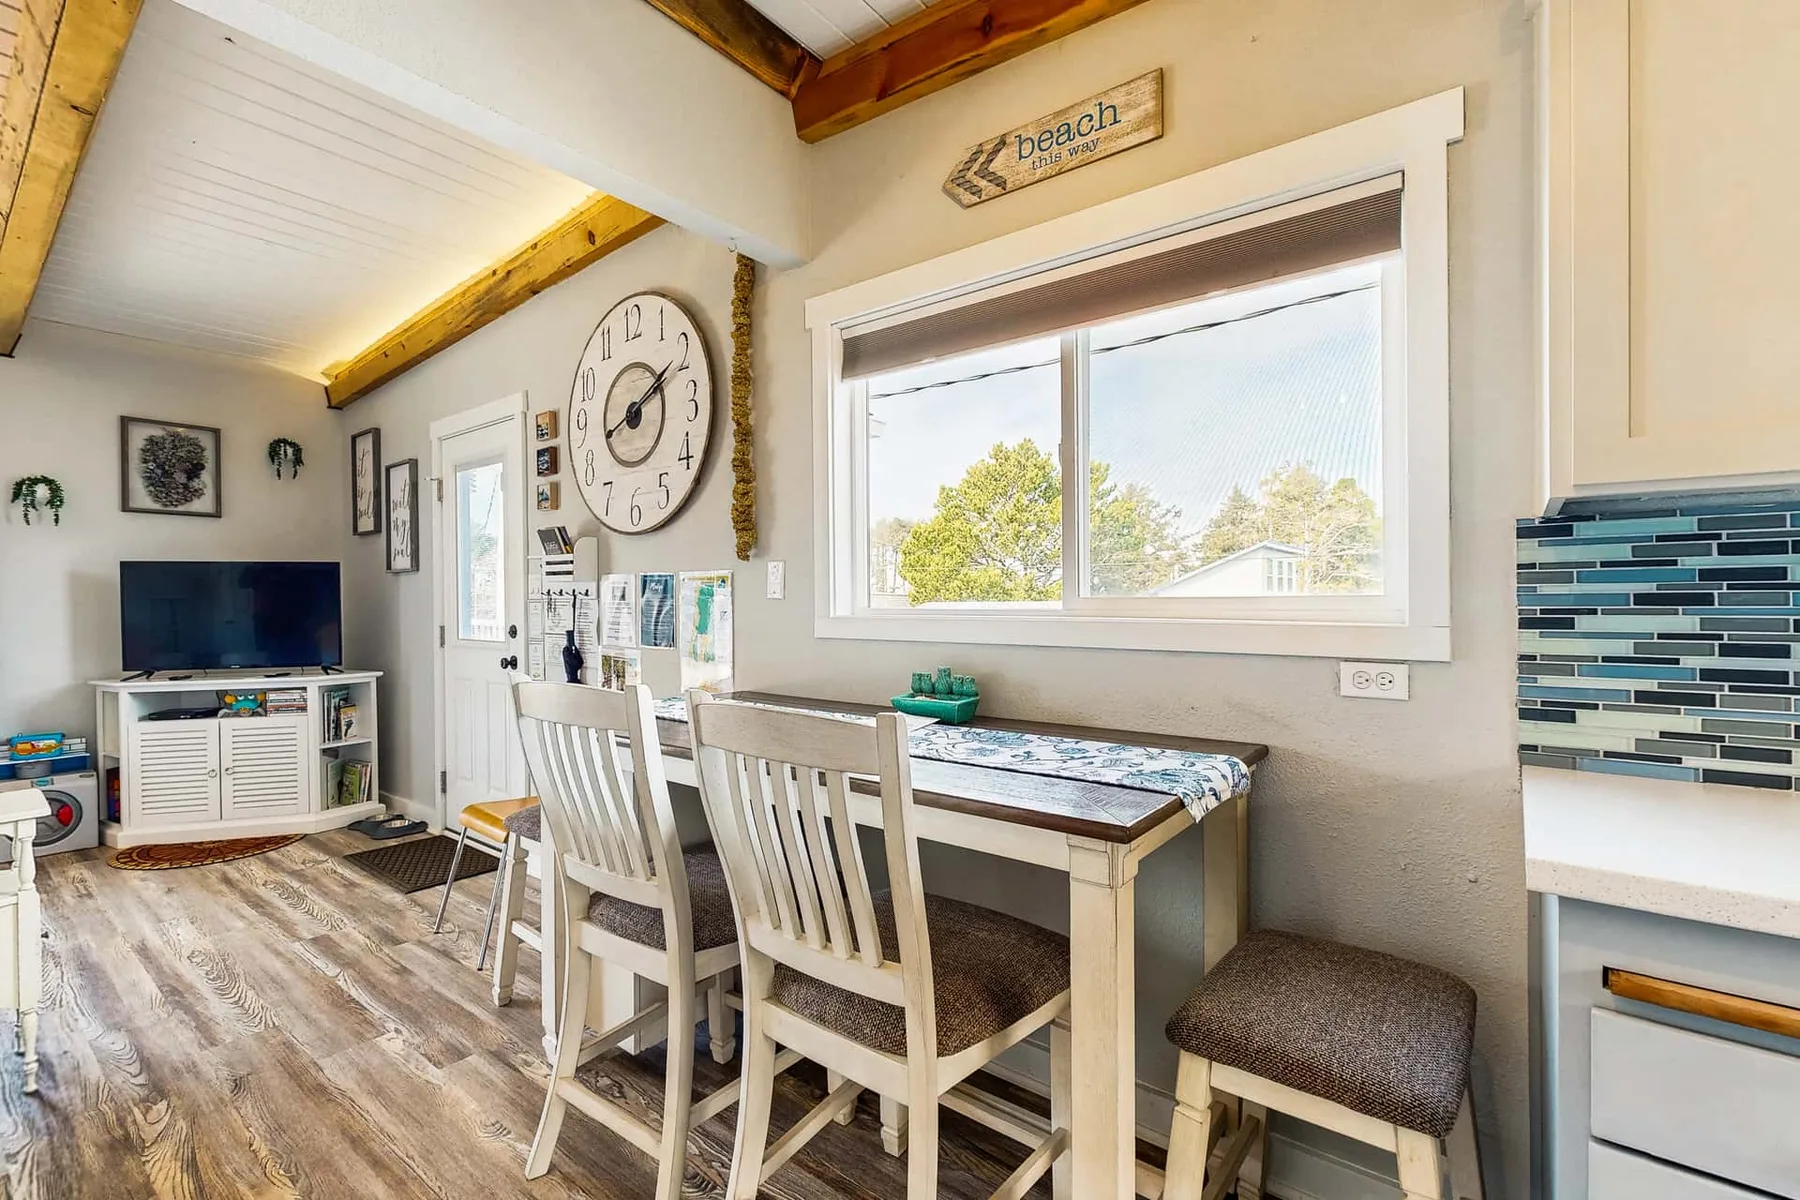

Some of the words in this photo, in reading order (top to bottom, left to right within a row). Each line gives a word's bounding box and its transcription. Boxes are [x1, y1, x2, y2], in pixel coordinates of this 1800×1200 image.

[1015, 101, 1121, 161] beach
[1031, 149, 1062, 171] this
[1069, 137, 1100, 158] way
[624, 303, 642, 342] 12
[658, 305, 666, 341] 1
[601, 325, 612, 361] 11
[677, 332, 690, 371] 2
[581, 367, 595, 402] 10
[685, 379, 698, 422] 3
[577, 408, 587, 448] 9
[585, 450, 595, 486] 8
[678, 431, 694, 470] 4
[603, 481, 613, 516] 7
[630, 487, 642, 526] 6
[657, 472, 670, 509] 5
